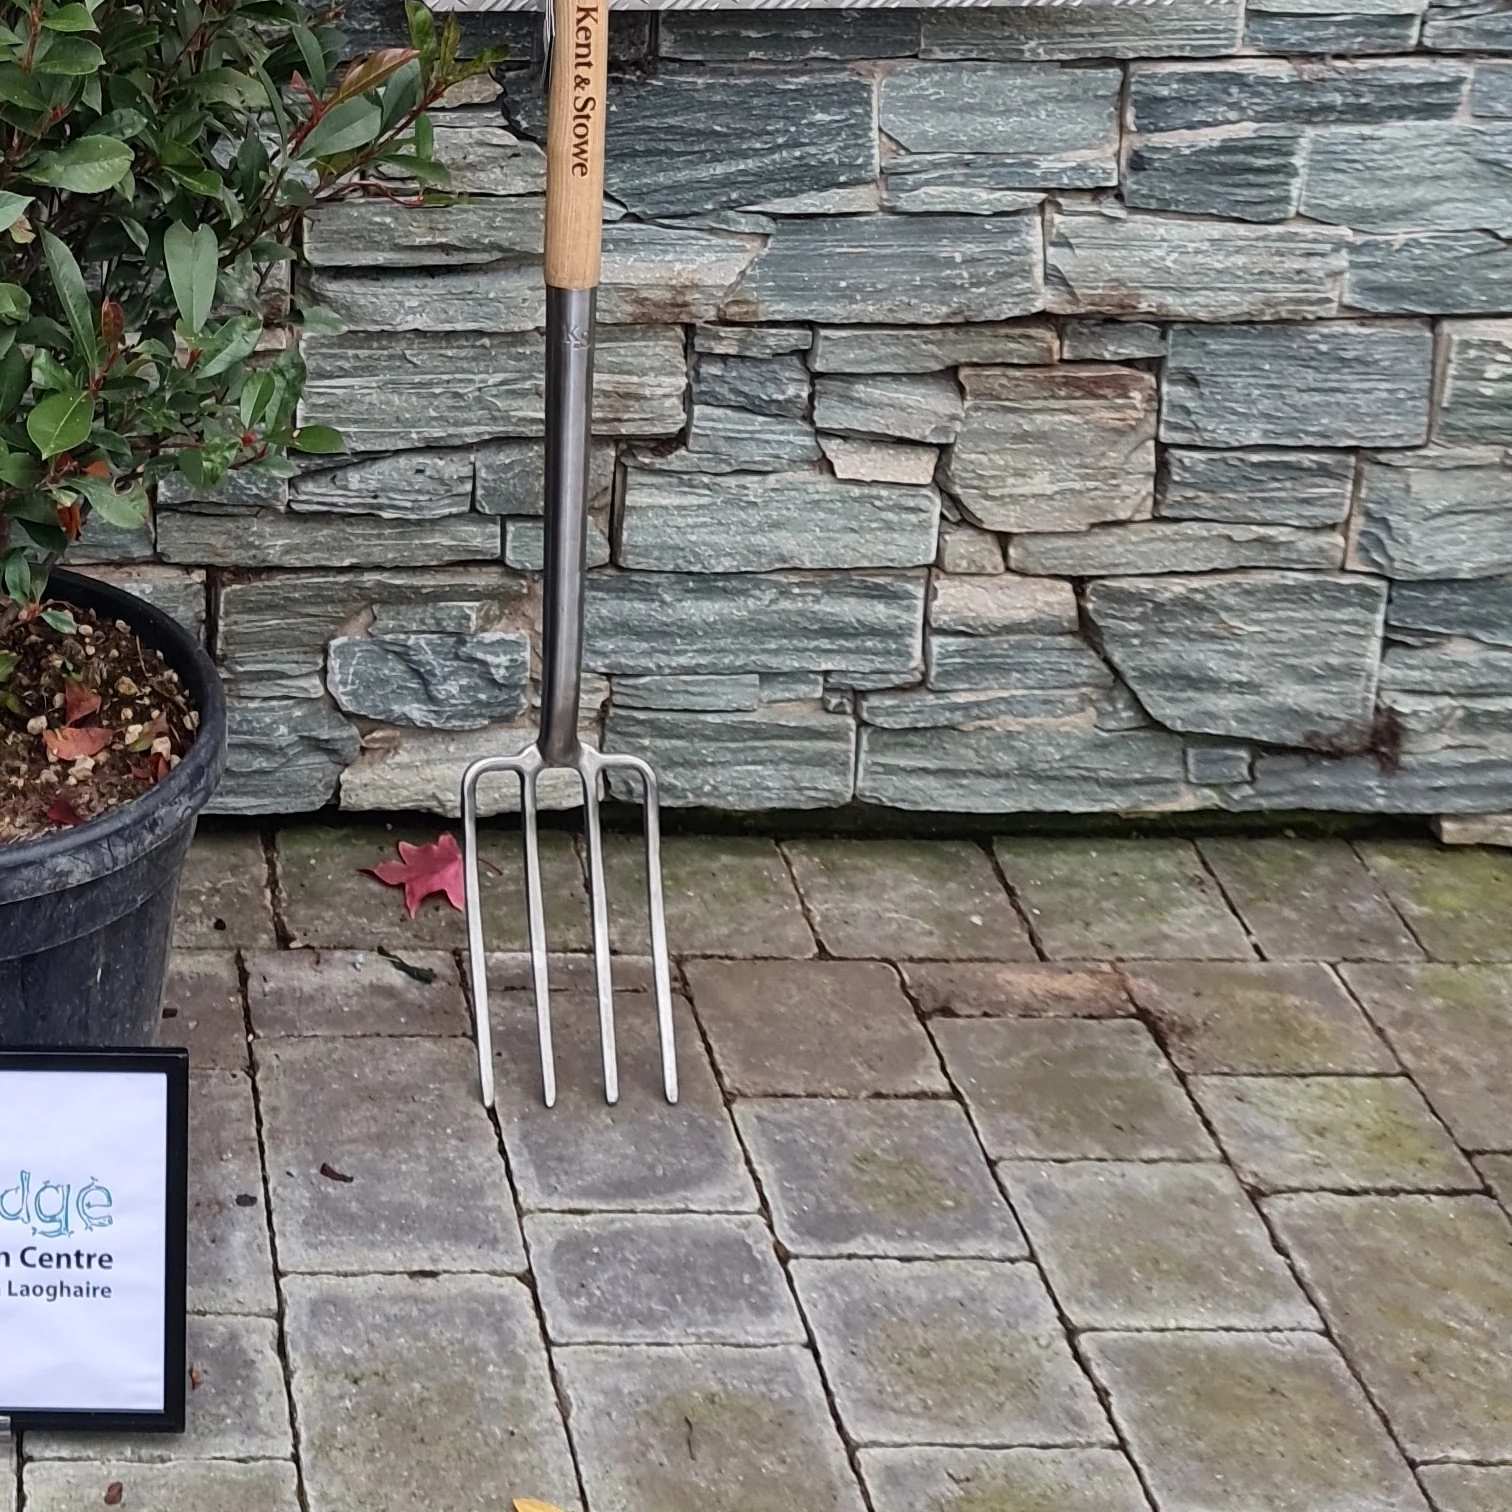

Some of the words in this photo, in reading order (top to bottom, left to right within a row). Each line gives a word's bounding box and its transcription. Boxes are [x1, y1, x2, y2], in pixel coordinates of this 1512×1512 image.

[573, 4, 599, 70] Kent
[573, 73, 591, 92] &
[571, 95, 597, 178] Stowe
[18, 1244, 115, 1271] Centre
[6, 1279, 113, 1303] Laoghaire
